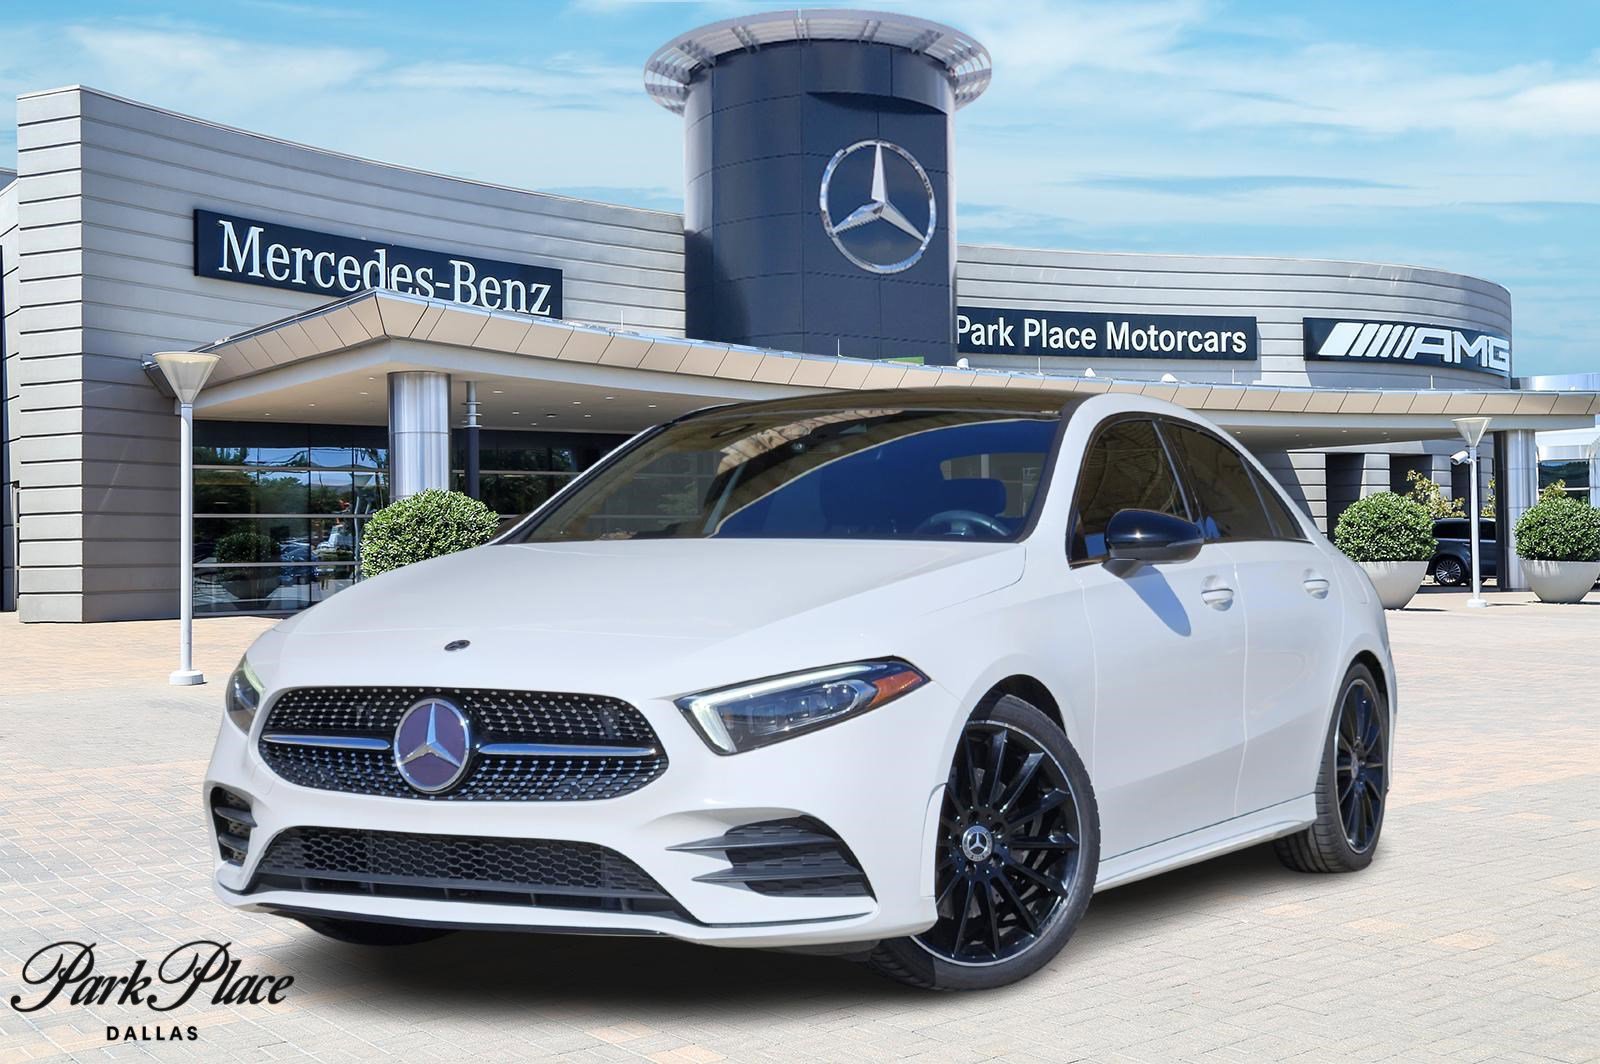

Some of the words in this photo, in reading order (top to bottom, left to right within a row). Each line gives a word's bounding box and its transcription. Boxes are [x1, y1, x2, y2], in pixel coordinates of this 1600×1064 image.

[218, 219, 552, 316] Mercedes-Benz
[956, 314, 1015, 347] Park
[1024, 318, 1097, 350] Place
[1106, 321, 1247, 353] Motorcars
